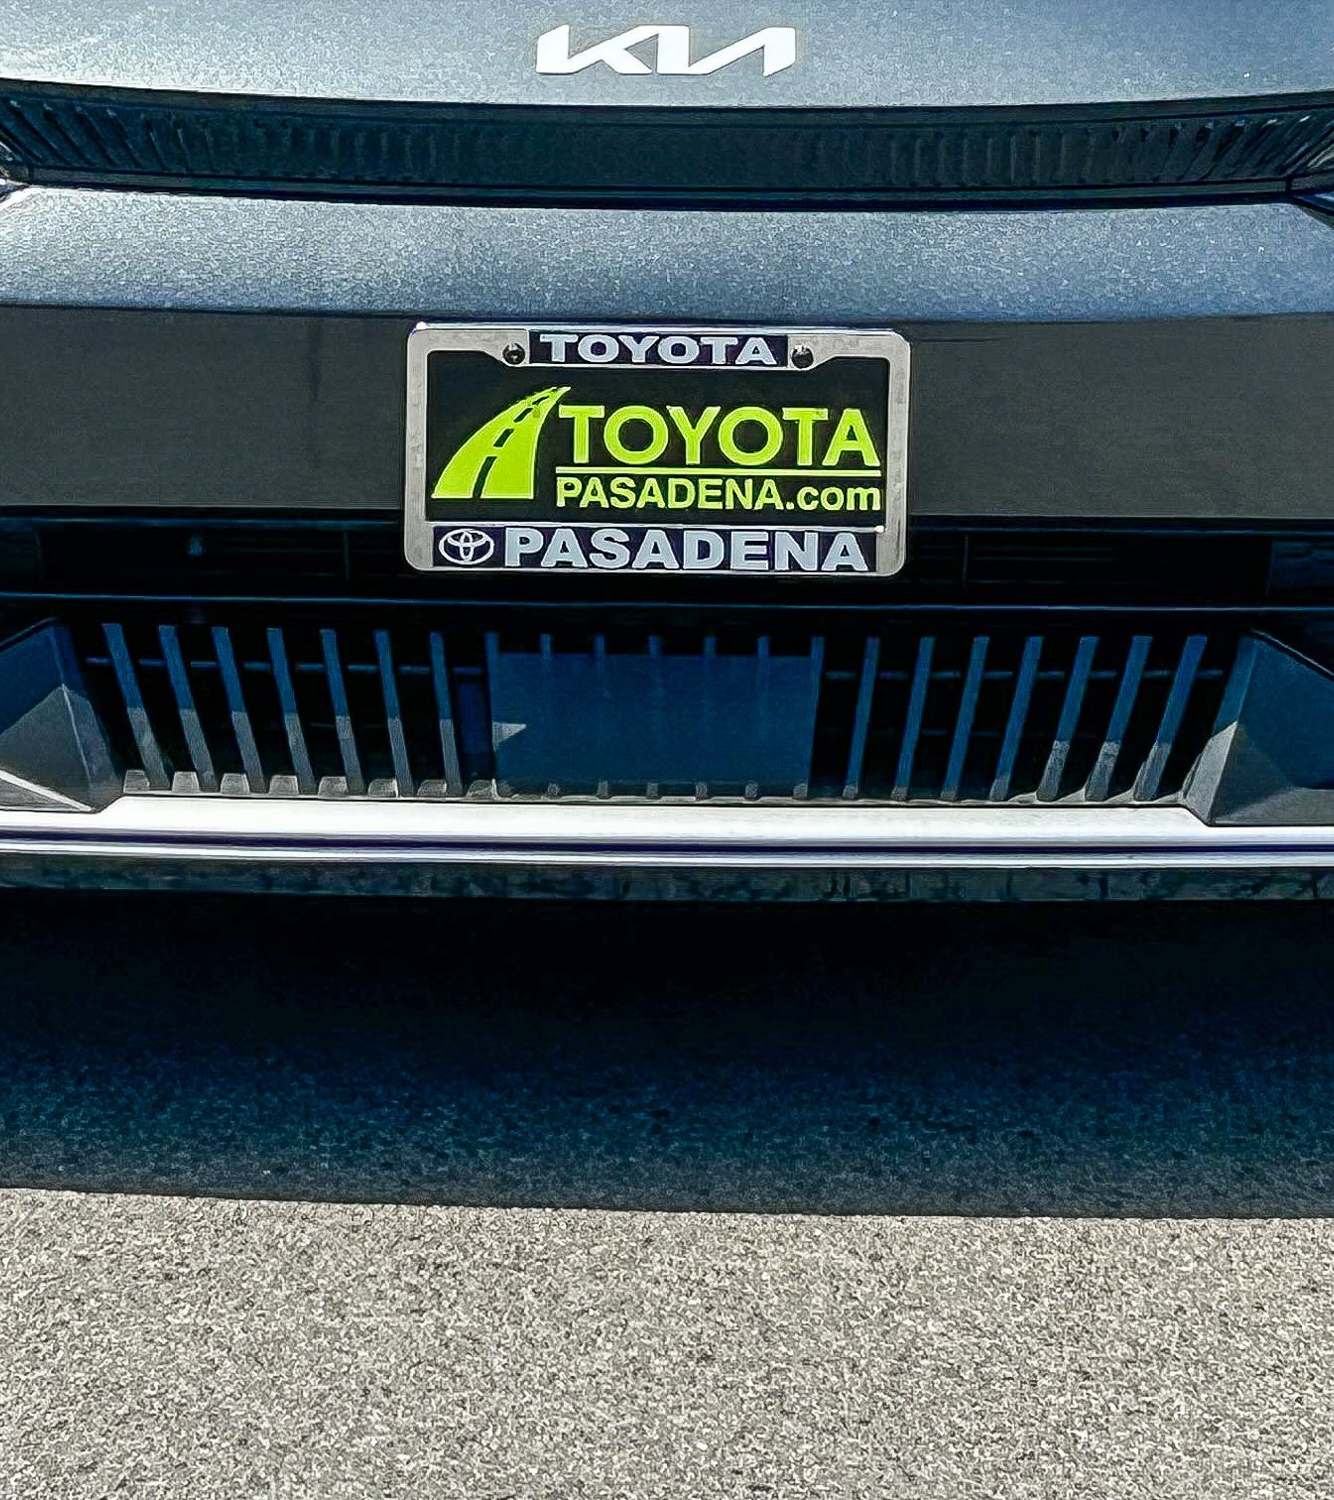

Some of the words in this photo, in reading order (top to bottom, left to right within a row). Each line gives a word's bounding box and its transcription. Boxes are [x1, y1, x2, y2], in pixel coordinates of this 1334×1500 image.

[535, 24, 796, 77] KIA
[539, 333, 777, 365] TOYOTA
[558, 405, 881, 467] TOYOTA
[556, 476, 881, 511] PASADENA.com
[504, 527, 870, 572] PASADENA
